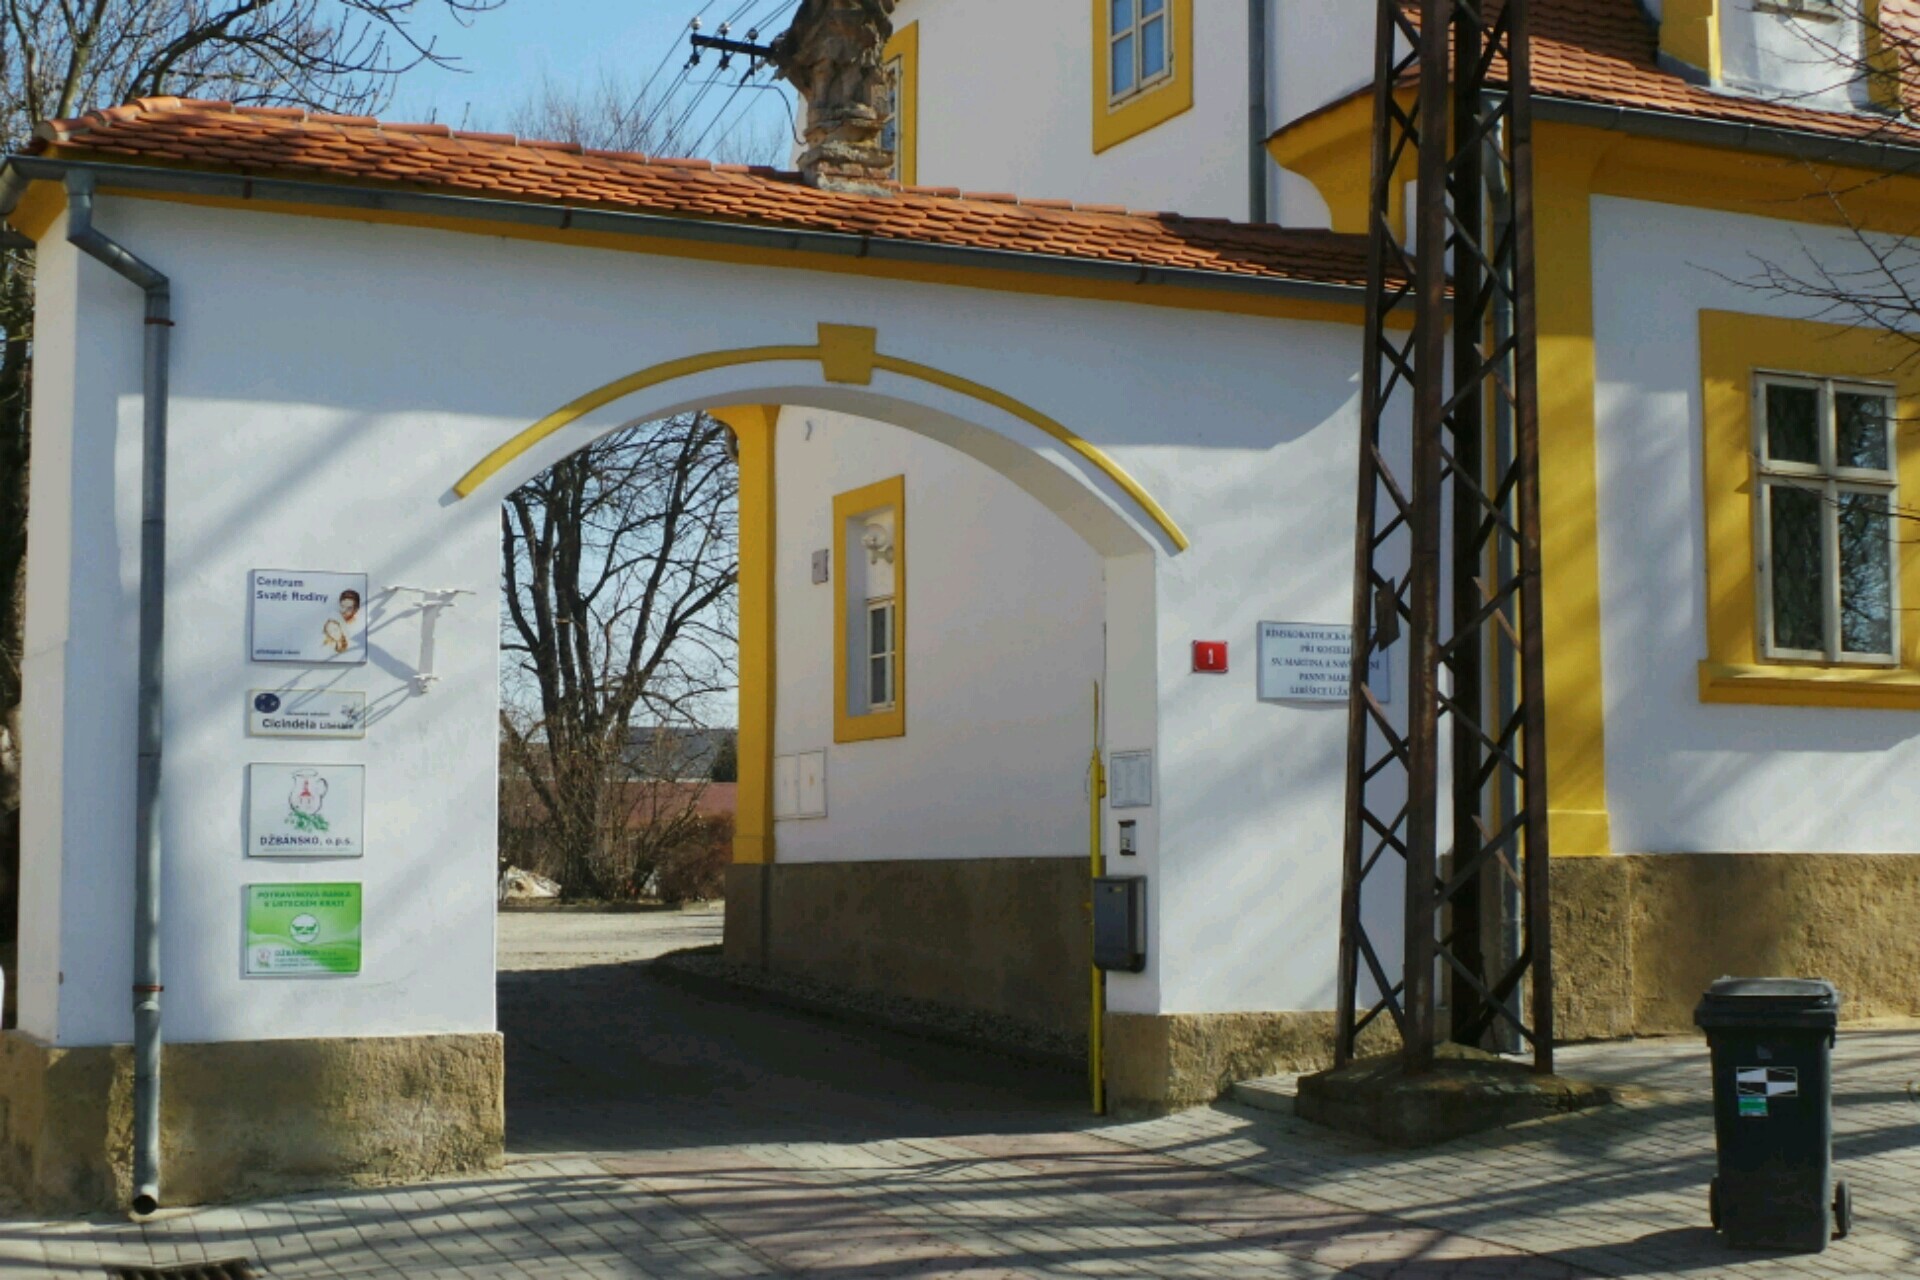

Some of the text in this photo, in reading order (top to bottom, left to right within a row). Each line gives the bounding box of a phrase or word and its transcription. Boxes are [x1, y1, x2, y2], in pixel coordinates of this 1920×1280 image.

[256, 576, 304, 588] Centrum
[256, 590, 328, 603] Svaté Rodiny
[1208, 648, 1214, 665] 1
[262, 718, 317, 730] Cicindela
